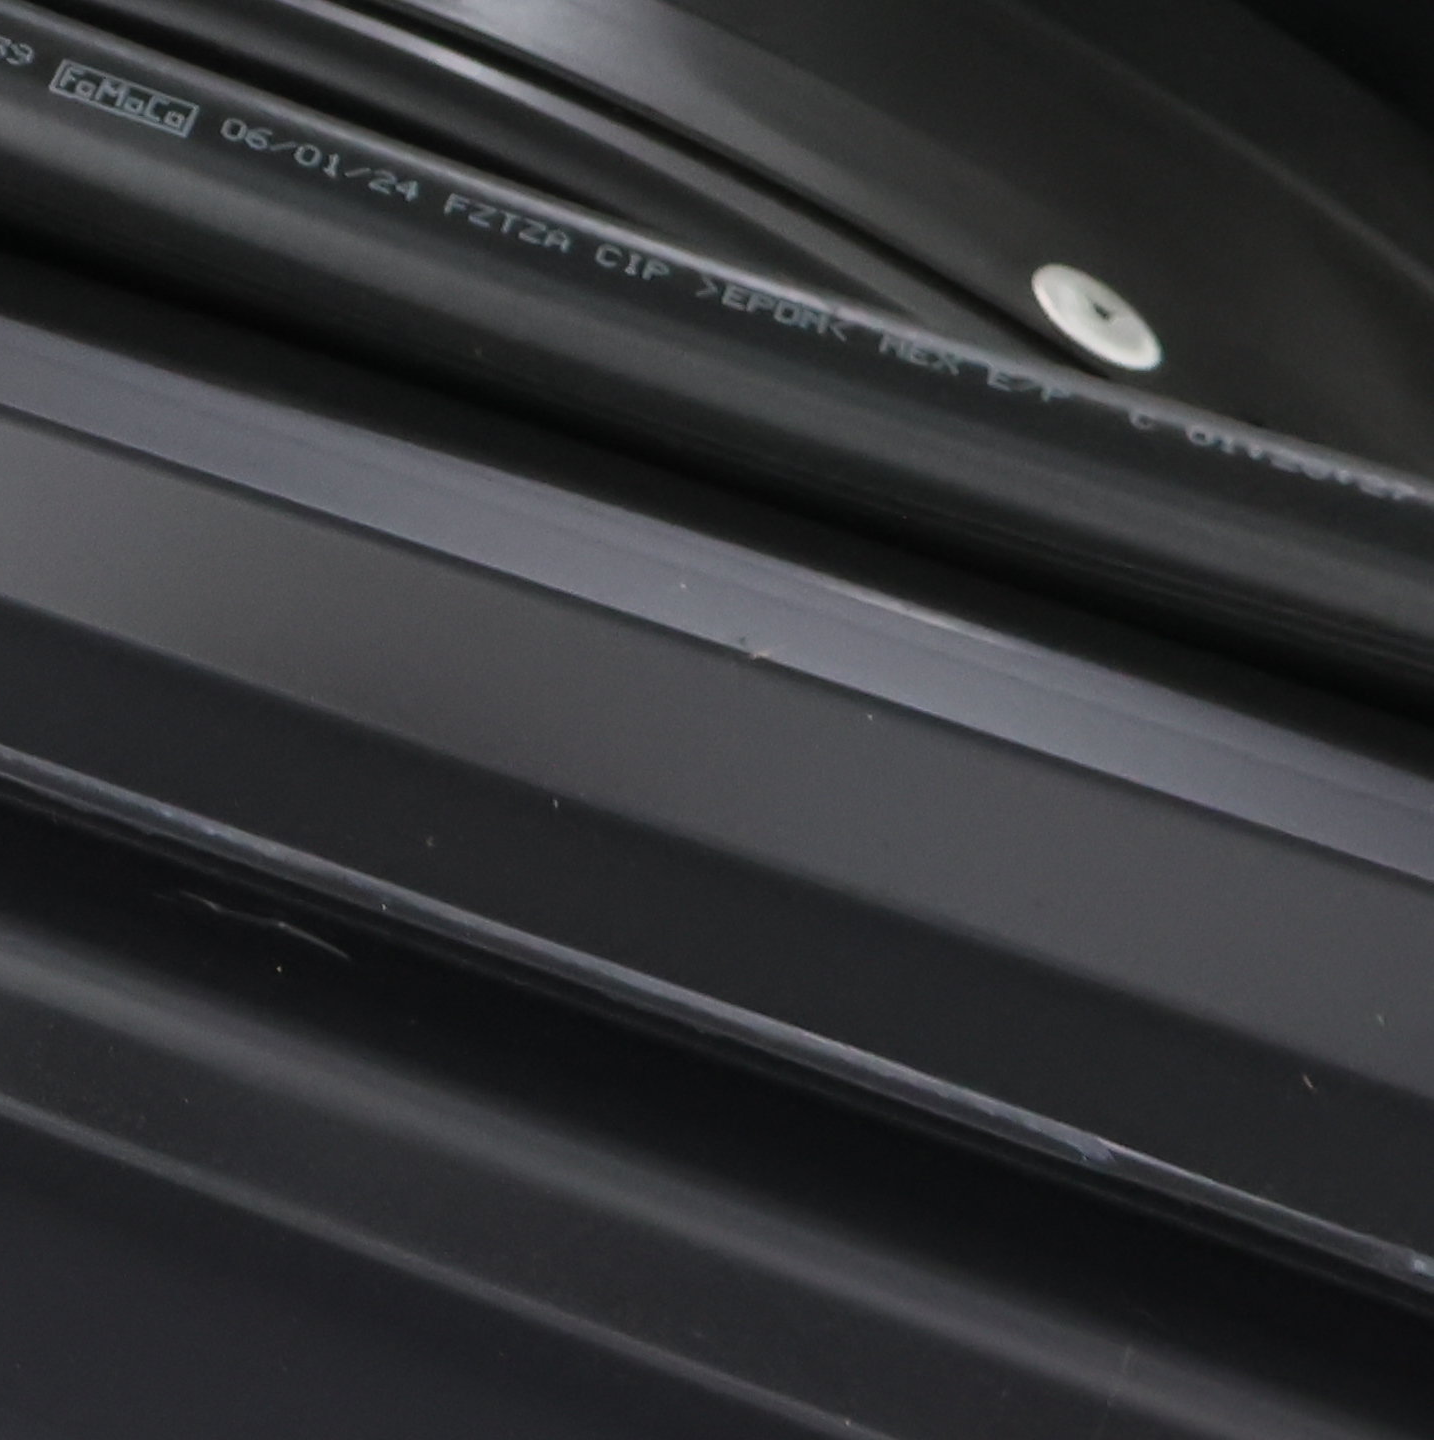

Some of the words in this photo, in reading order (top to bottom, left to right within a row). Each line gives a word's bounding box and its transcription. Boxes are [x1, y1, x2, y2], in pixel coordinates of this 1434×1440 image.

[59, 67, 186, 128] FoMoCo
[220, 117, 419, 203] 06/01/24
[594, 244, 670, 281] CIP
